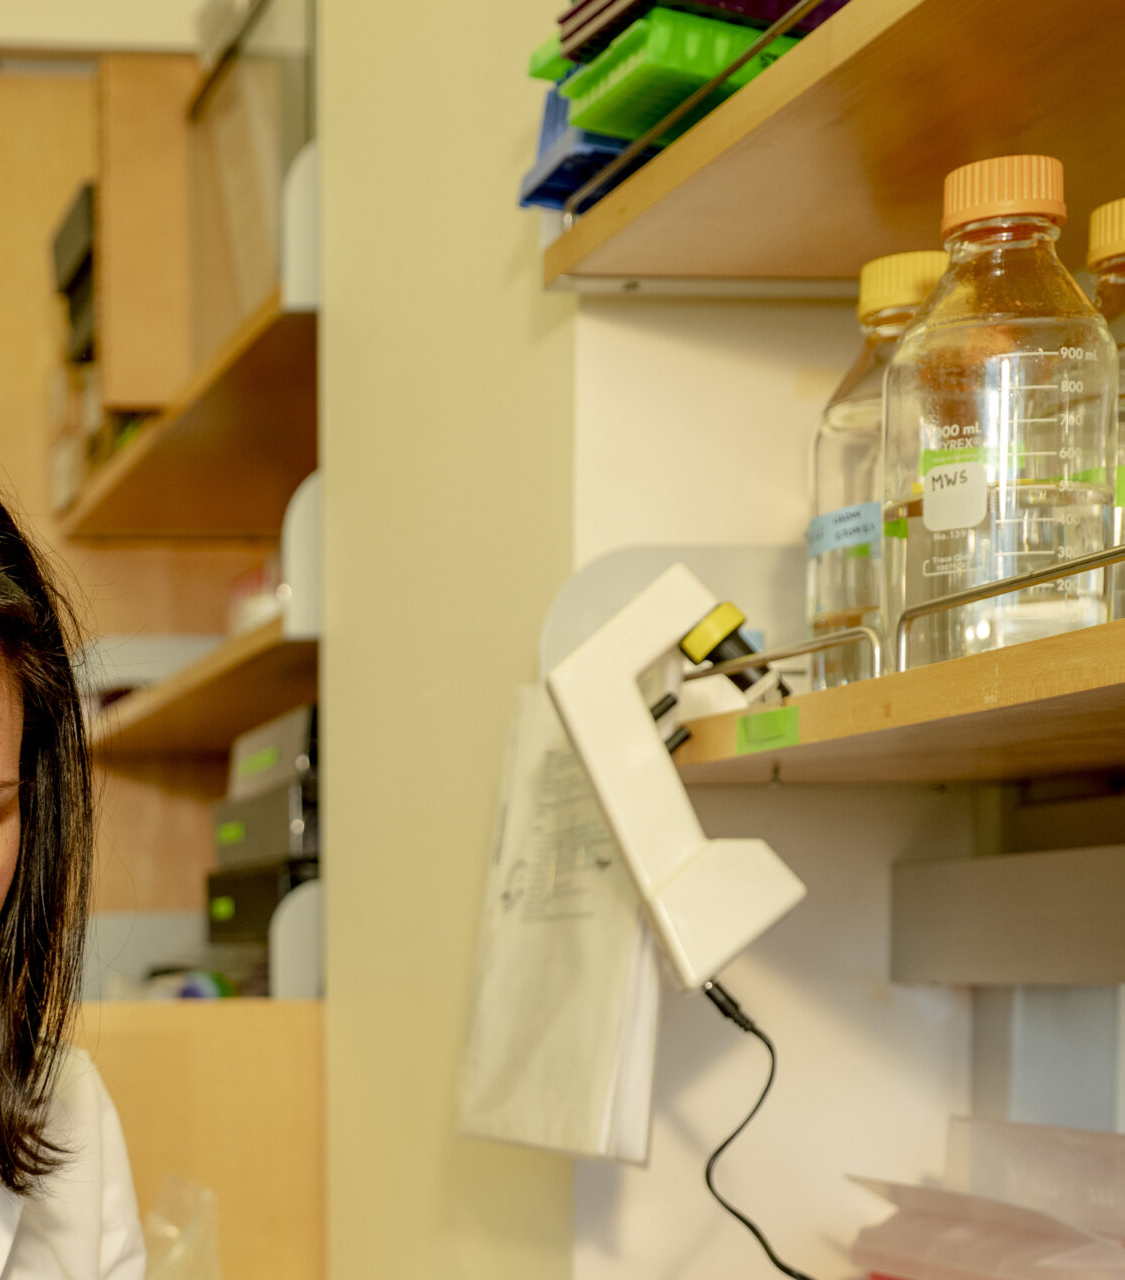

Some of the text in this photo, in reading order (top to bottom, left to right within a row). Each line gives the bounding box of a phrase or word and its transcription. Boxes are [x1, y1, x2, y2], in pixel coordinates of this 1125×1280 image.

[1060, 347, 1083, 360] 900
[1060, 380, 1083, 393] 800
[963, 422, 982, 435] mL
[1058, 447, 1082, 459] 600
